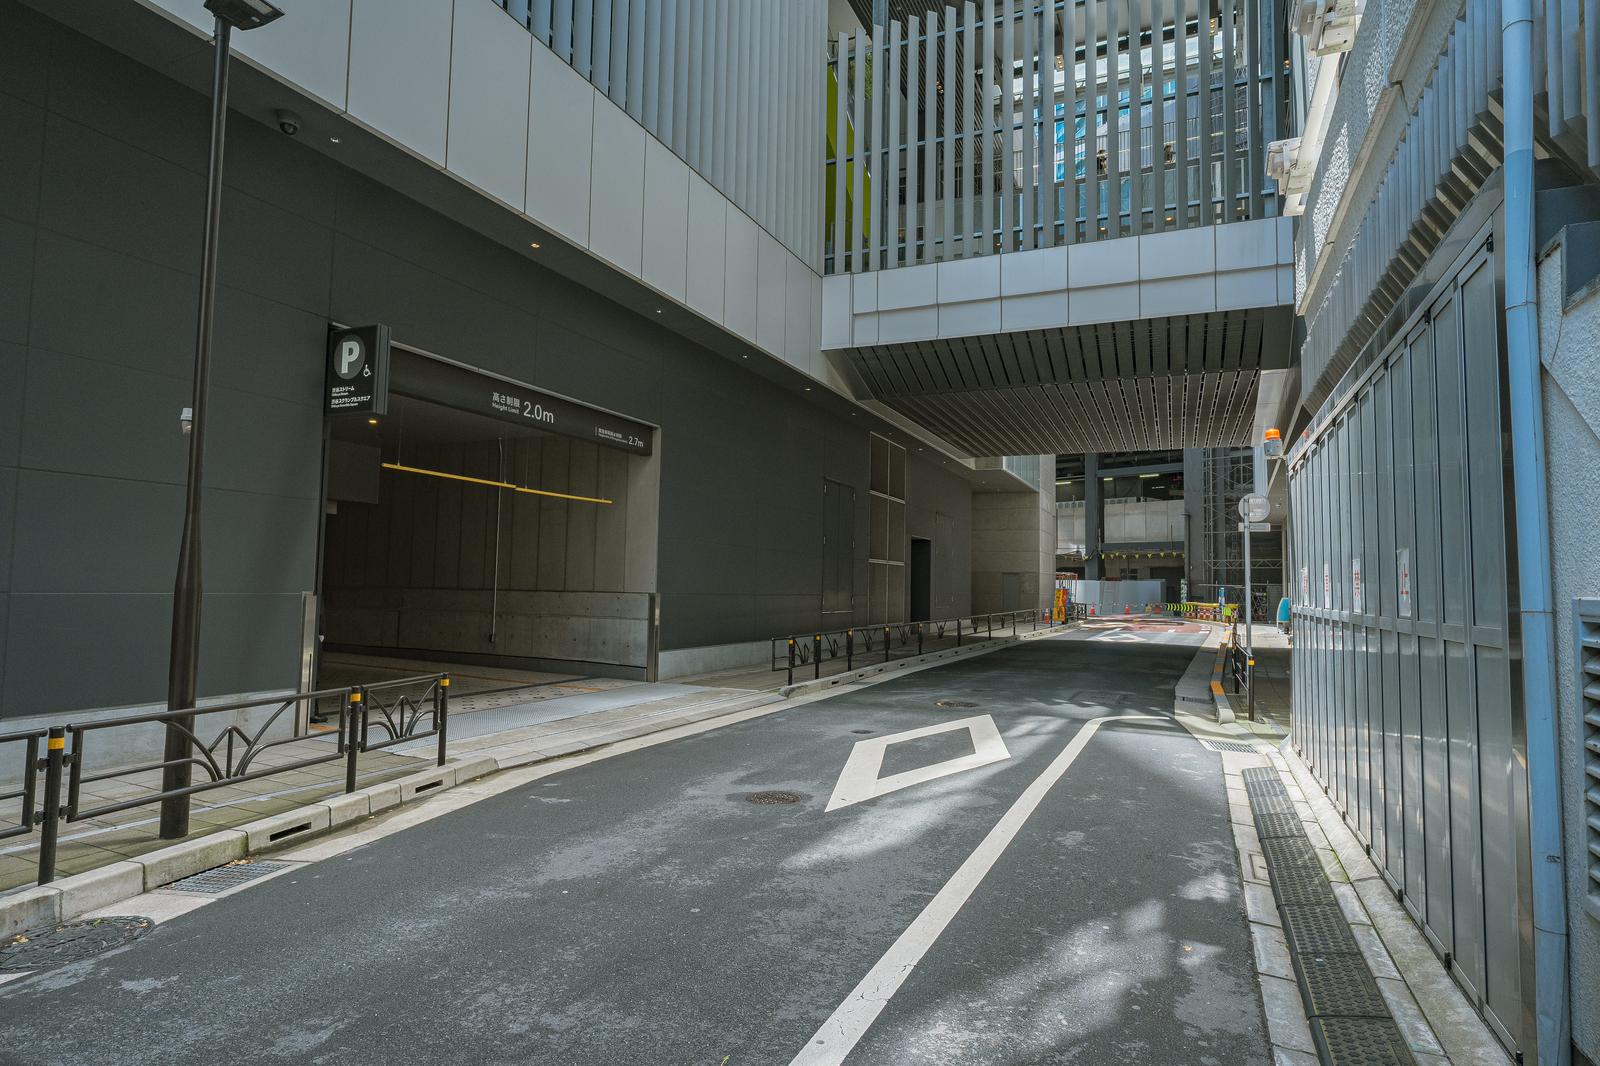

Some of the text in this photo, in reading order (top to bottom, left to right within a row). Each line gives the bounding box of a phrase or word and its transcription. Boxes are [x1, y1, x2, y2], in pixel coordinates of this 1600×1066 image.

[341, 341, 360, 374] P
[491, 402, 520, 415] Height Limit
[492, 391, 554, 424] 高さ制限 2.0m
[628, 435, 644, 448] 2.7m
